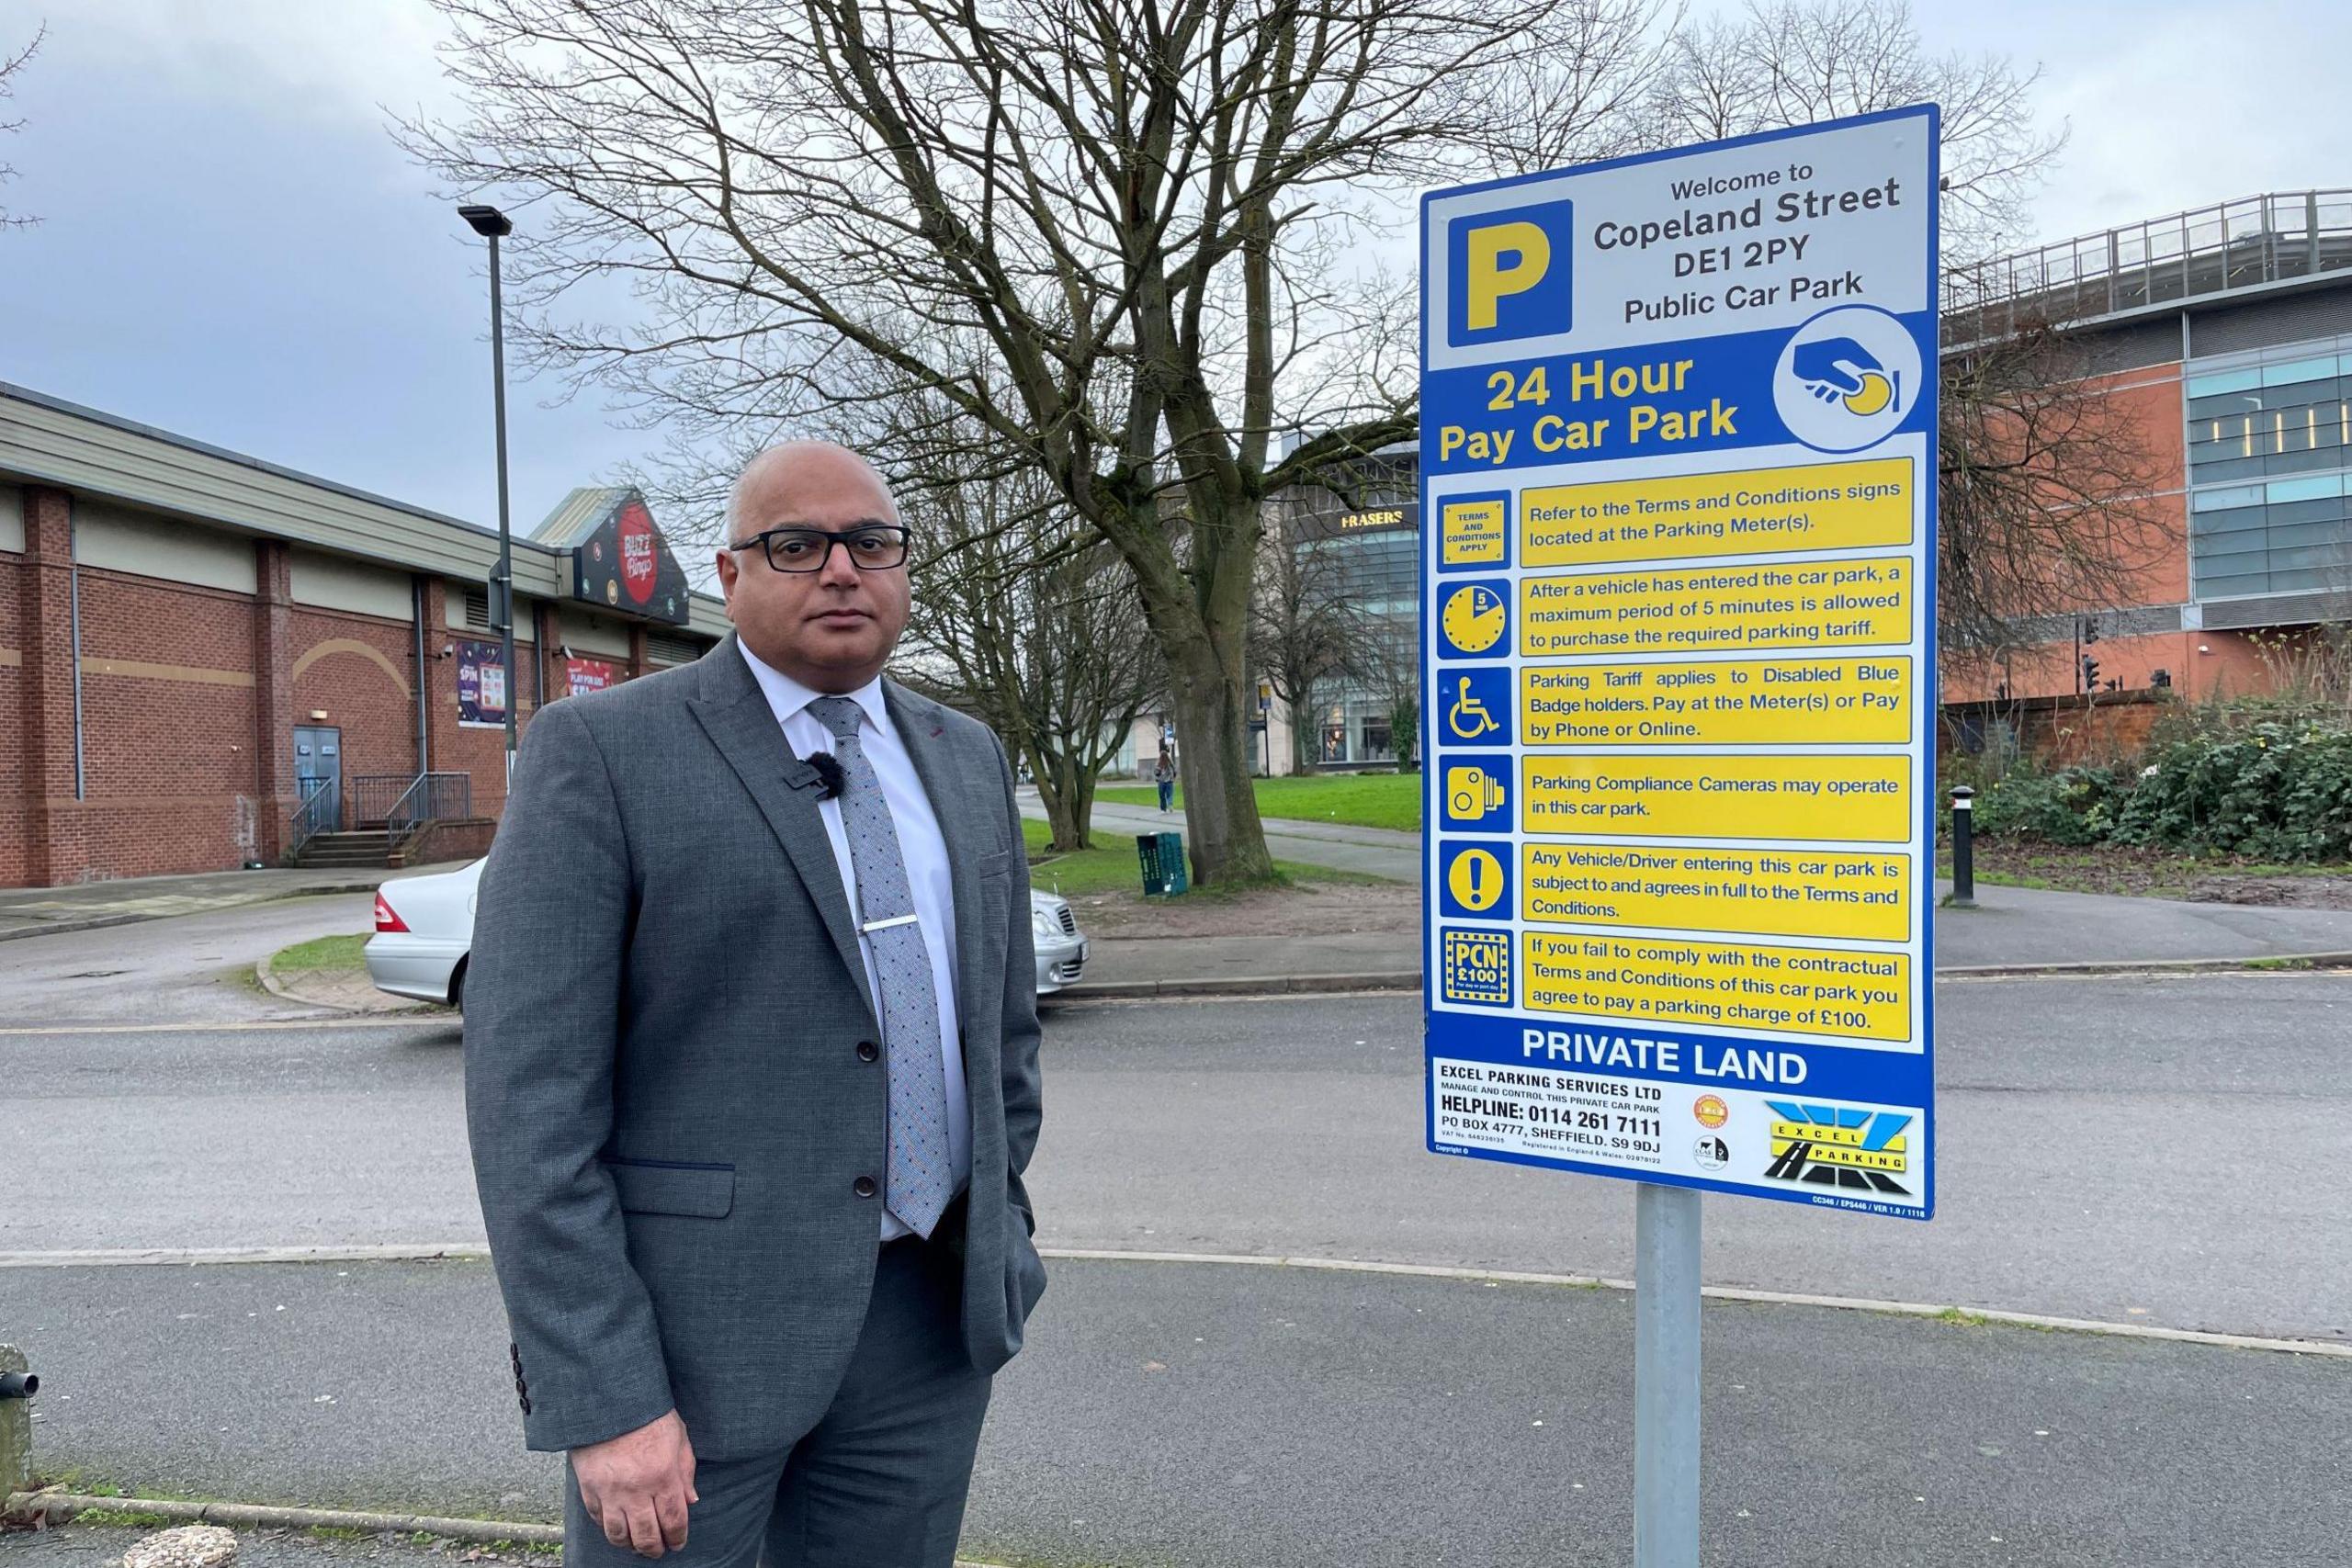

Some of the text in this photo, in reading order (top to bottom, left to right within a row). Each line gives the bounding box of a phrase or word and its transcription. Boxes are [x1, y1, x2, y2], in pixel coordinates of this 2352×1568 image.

[1670, 164, 1813, 200] Welcome to
[1594, 176, 1900, 250] Copeland Street
[1674, 234, 1810, 277] DE1 2PY
[1468, 220, 1551, 331] P
[1625, 270, 1863, 323] Public Car Park
[1487, 359, 1693, 412] 24 Hour
[1441, 398, 1738, 465] Pay Car Park
[1458, 513, 1489, 521] TERMS
[1530, 482, 1901, 522] Refer to the Terms and Conditions signs
[1342, 511, 1403, 528] FRASERS
[1530, 513, 1815, 547] located at the Parking Meter(s).
[625, 534, 651, 557] BUZZ
[1447, 532, 1500, 543] CONDITIONS
[1460, 544, 1487, 552] APPLY
[1478, 592, 1486, 604] 5
[1530, 566, 1900, 599] After a vehicle has entered the car park, a
[1530, 592, 1900, 623] maximum period of 5 minutes is allowed
[1530, 620, 1875, 649] to purchase the required parking tariff.
[1530, 665, 1900, 691] Parking Tariff applies to Disabled Blue
[1531, 693, 1900, 716] Badge holders. Pay at the Meter(s) or Pay
[1532, 775, 1898, 795] Parking Compliance Cameras may operate
[1532, 799, 1650, 818] in this car park.
[1532, 850, 1898, 878] Any Vehicle/Driver entering this car park is
[1532, 874, 1898, 905] subject to and agrees in full to the Terms and
[1456, 943, 1498, 968] PCN
[1532, 938, 1898, 976] If you fail to comply with the contractual
[1457, 967, 1497, 983] £100
[1532, 963, 1898, 1005] Terms and Conditions of this car park you
[1532, 990, 1871, 1029] agree to pay a parking charge of £100.
[1523, 1029, 1807, 1085] PRIVATE LAND
[1441, 1065, 1661, 1100] EXCEL PARKING SERVICES LTD
[1441, 1081, 1659, 1113] MANAGE AND CONTROL THIS PRIVATE CAR PARK
[1442, 1094, 1660, 1137] HELPLINE: 0114 261 7111
[1442, 1115, 1660, 1154] PO BOX 4777, SHEFFIELD. S9 9DJ
[1779, 1125, 1858, 1143] EXCEL
[1815, 1148, 1902, 1168] PARKING
